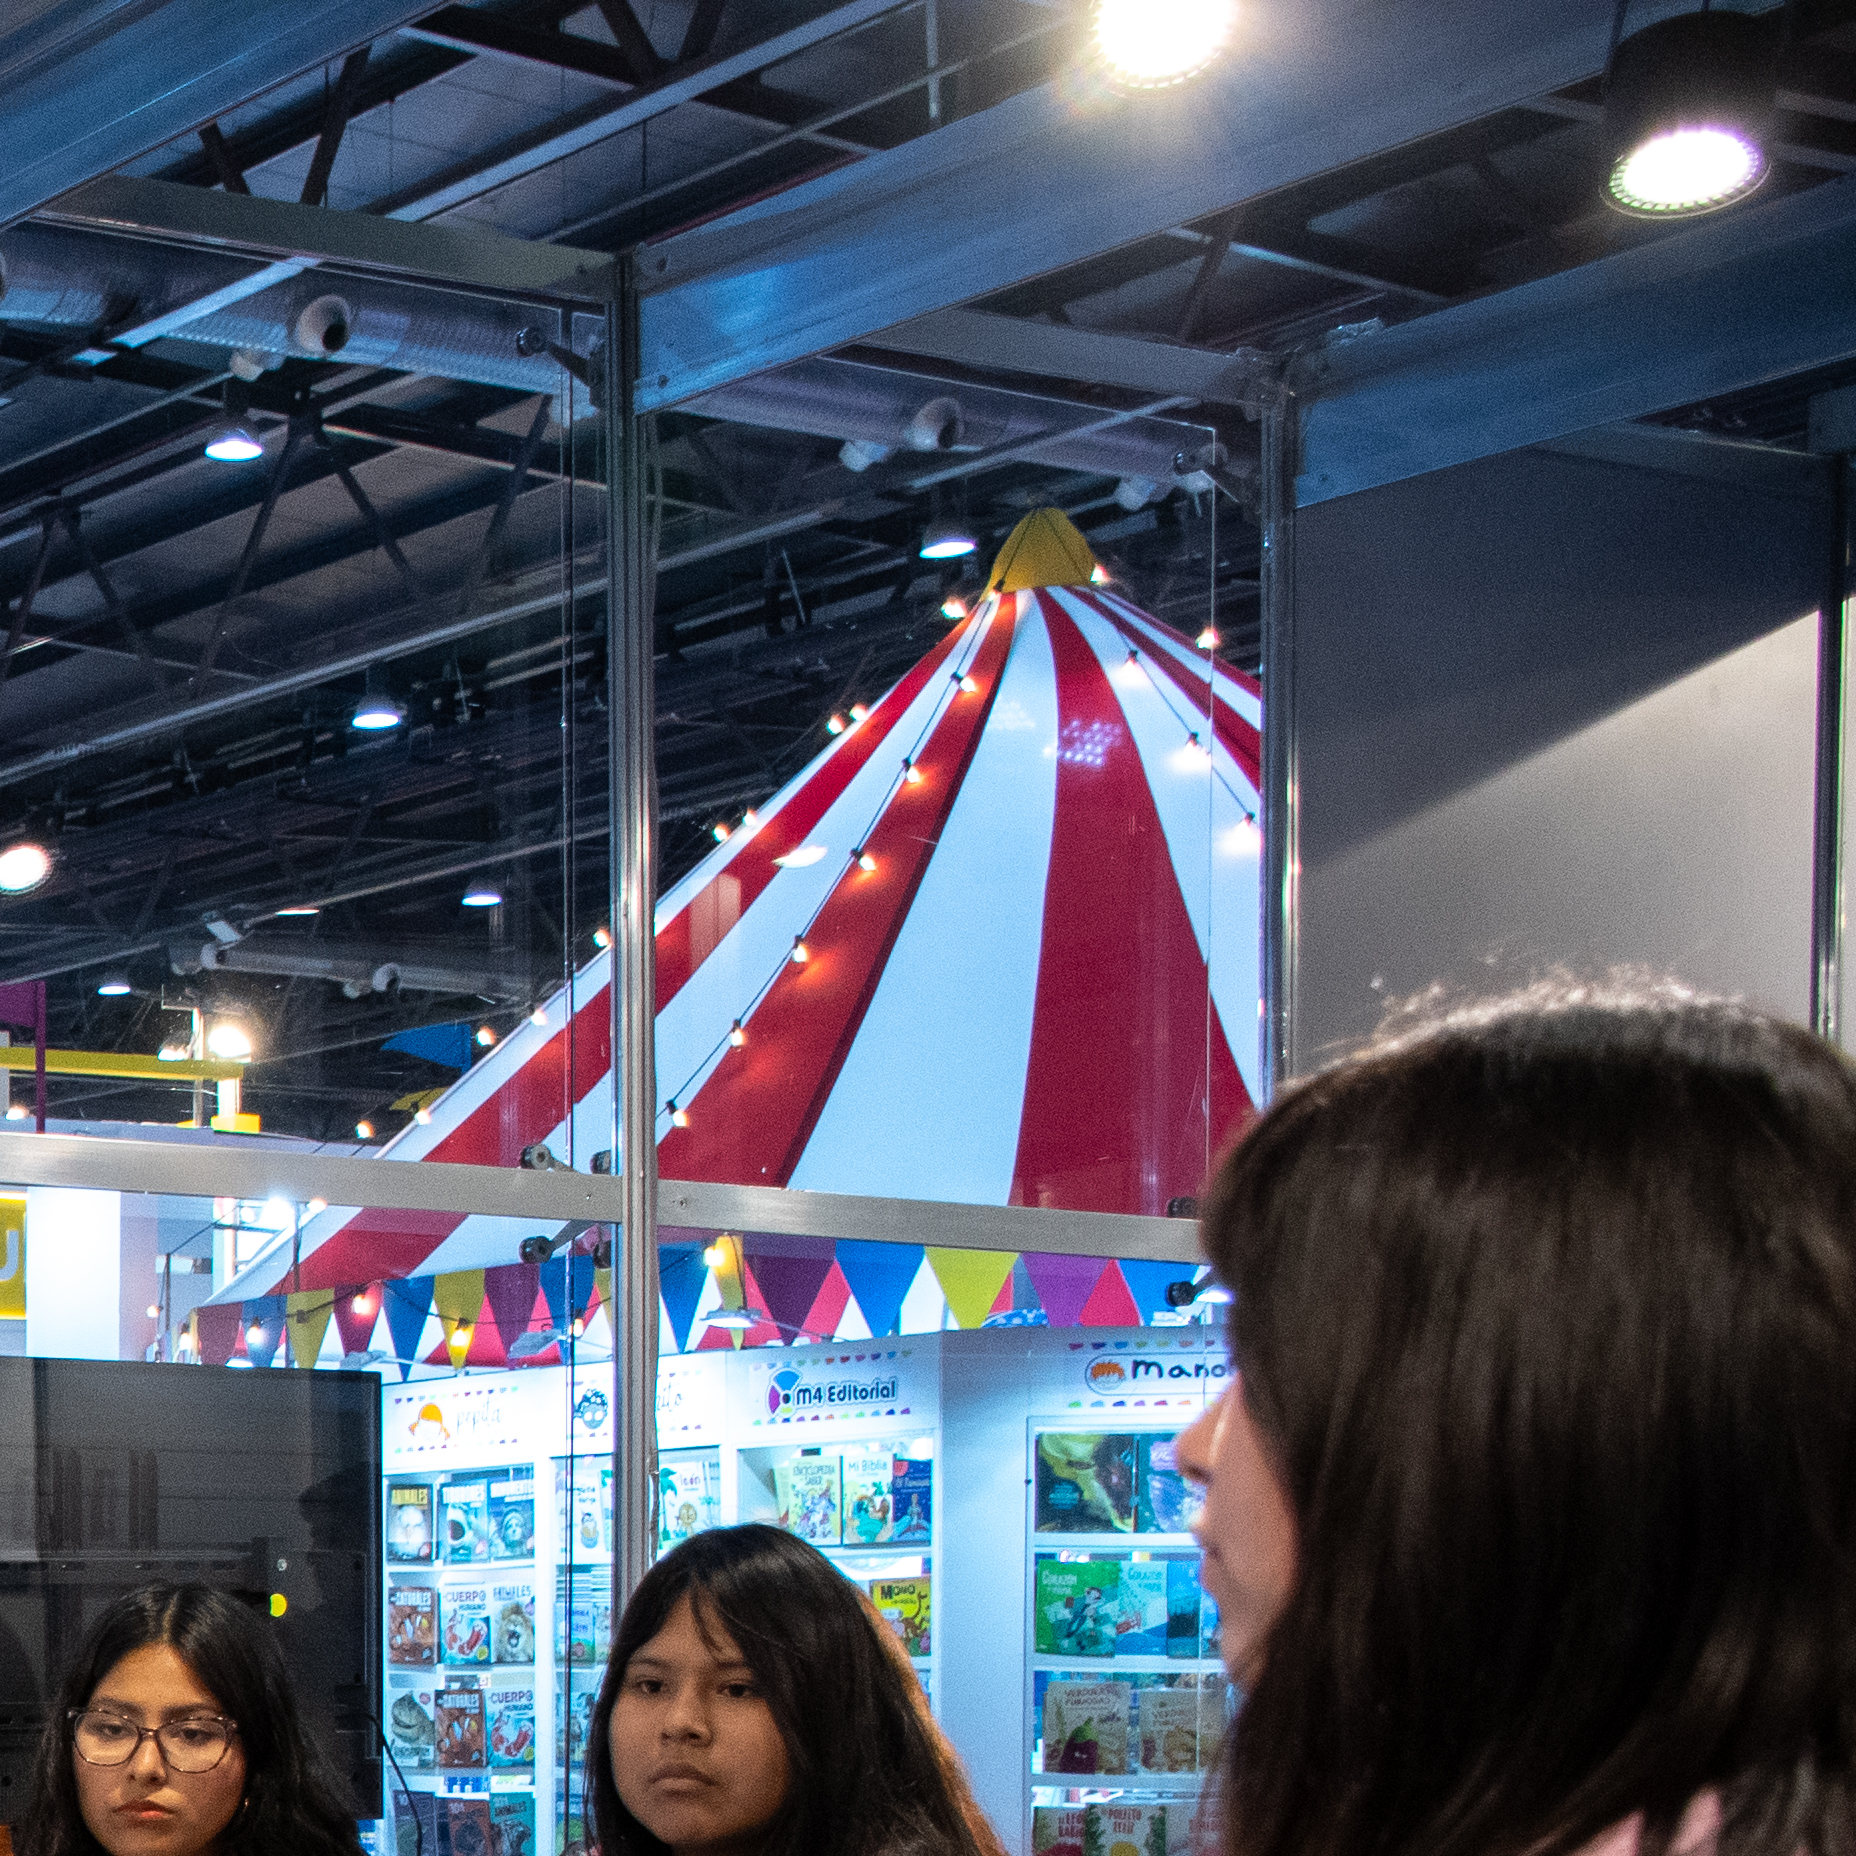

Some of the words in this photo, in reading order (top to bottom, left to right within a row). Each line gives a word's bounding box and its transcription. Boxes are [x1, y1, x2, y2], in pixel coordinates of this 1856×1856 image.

[827, 1379, 897, 1401] Editorial
[445, 1589, 487, 1602] CUERPO
[490, 1690, 533, 1704] CUERPO
